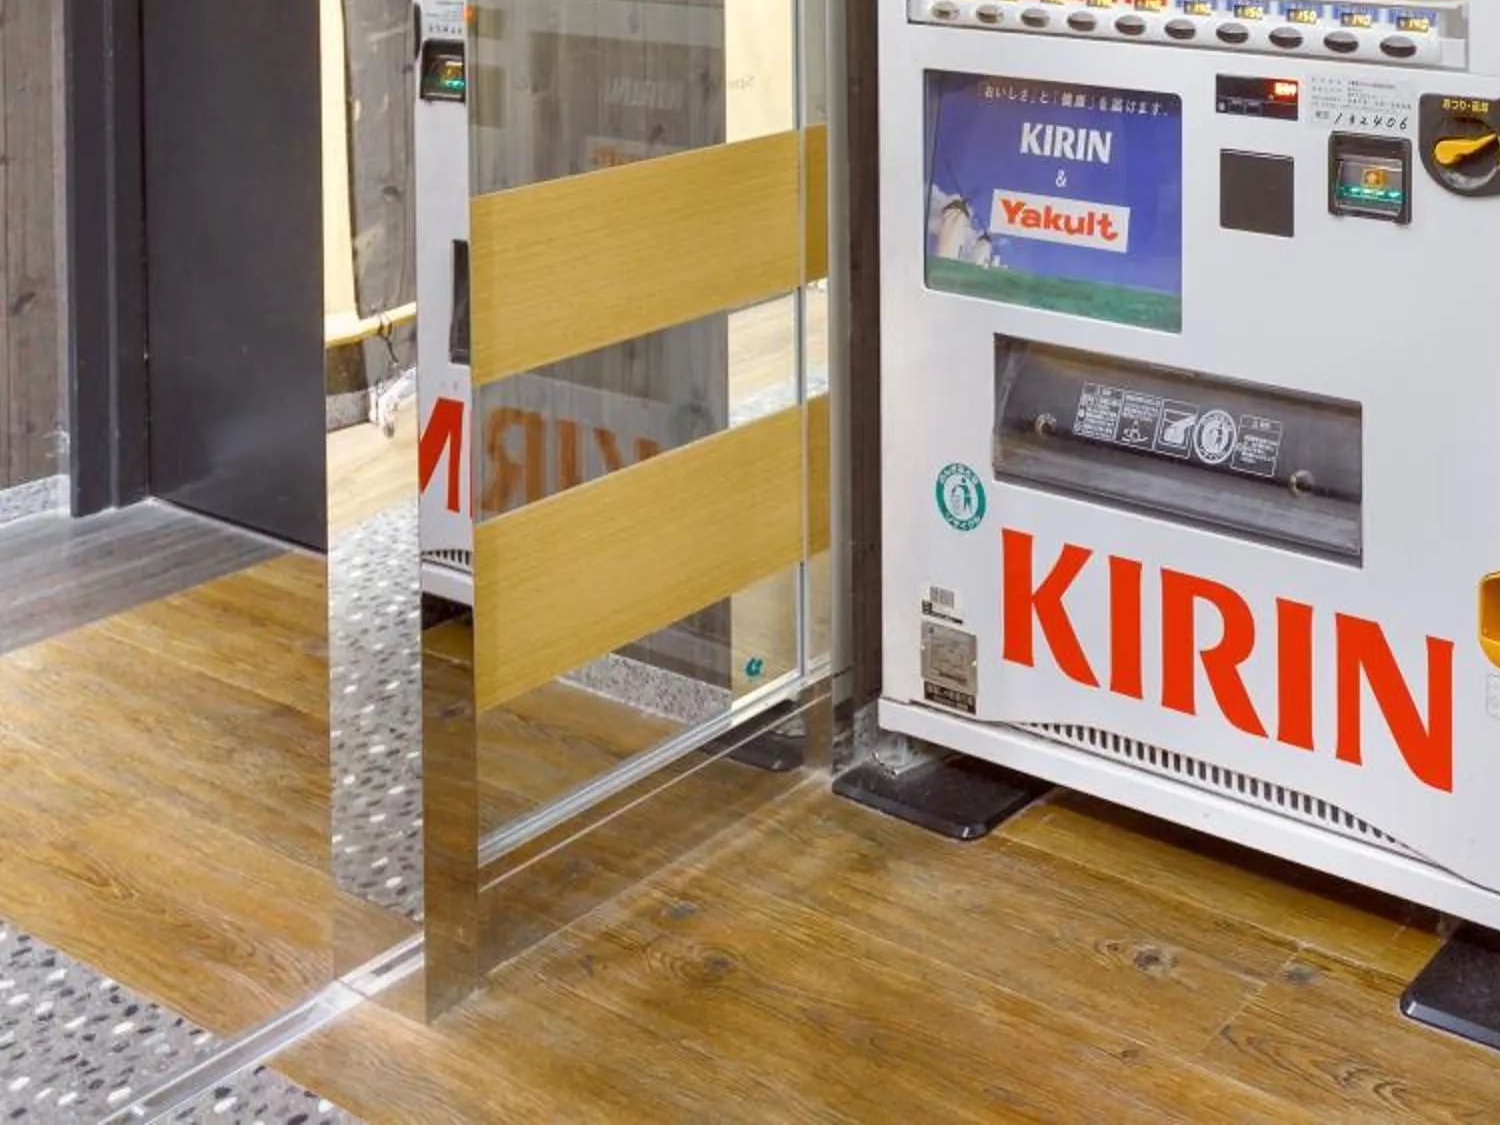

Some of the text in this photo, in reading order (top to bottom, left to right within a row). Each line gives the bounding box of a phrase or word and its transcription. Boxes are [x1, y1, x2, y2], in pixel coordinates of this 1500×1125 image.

[1020, 122, 1113, 164] KIRIN
[1055, 169, 1068, 188] &
[1000, 197, 1119, 242] Yakult
[1001, 526, 1455, 793] KIRIN
